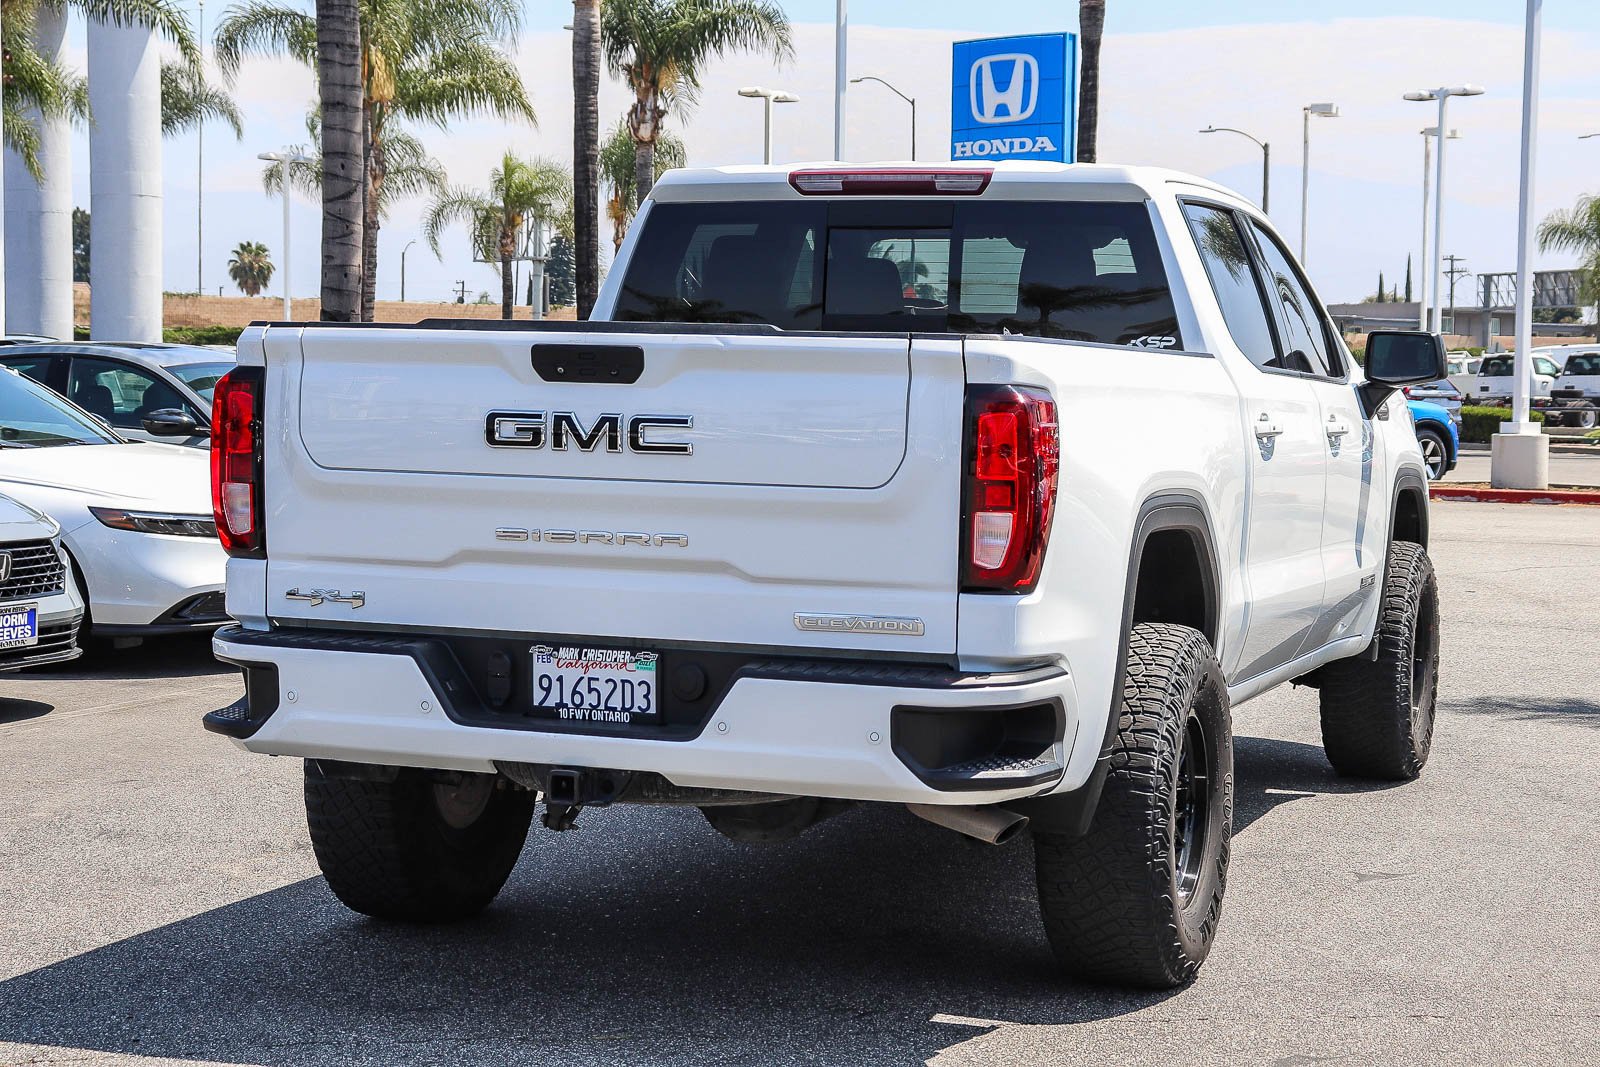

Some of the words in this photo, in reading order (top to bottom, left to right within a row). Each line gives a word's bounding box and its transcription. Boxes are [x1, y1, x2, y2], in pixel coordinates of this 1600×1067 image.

[953, 136, 1057, 158] HONDA
[484, 408, 694, 456] GMC
[495, 527, 689, 548] SIERRA
[803, 617, 914, 632] ELEVATION
[536, 654, 552, 664] FEB
[558, 646, 580, 660] MARK
[581, 648, 631, 663] CHRISTOPHER
[556, 657, 636, 675] California
[538, 673, 652, 713] 91652D3
[558, 707, 568, 719] 10
[569, 709, 590, 721] FWY
[591, 710, 631, 723] ONTARIO
